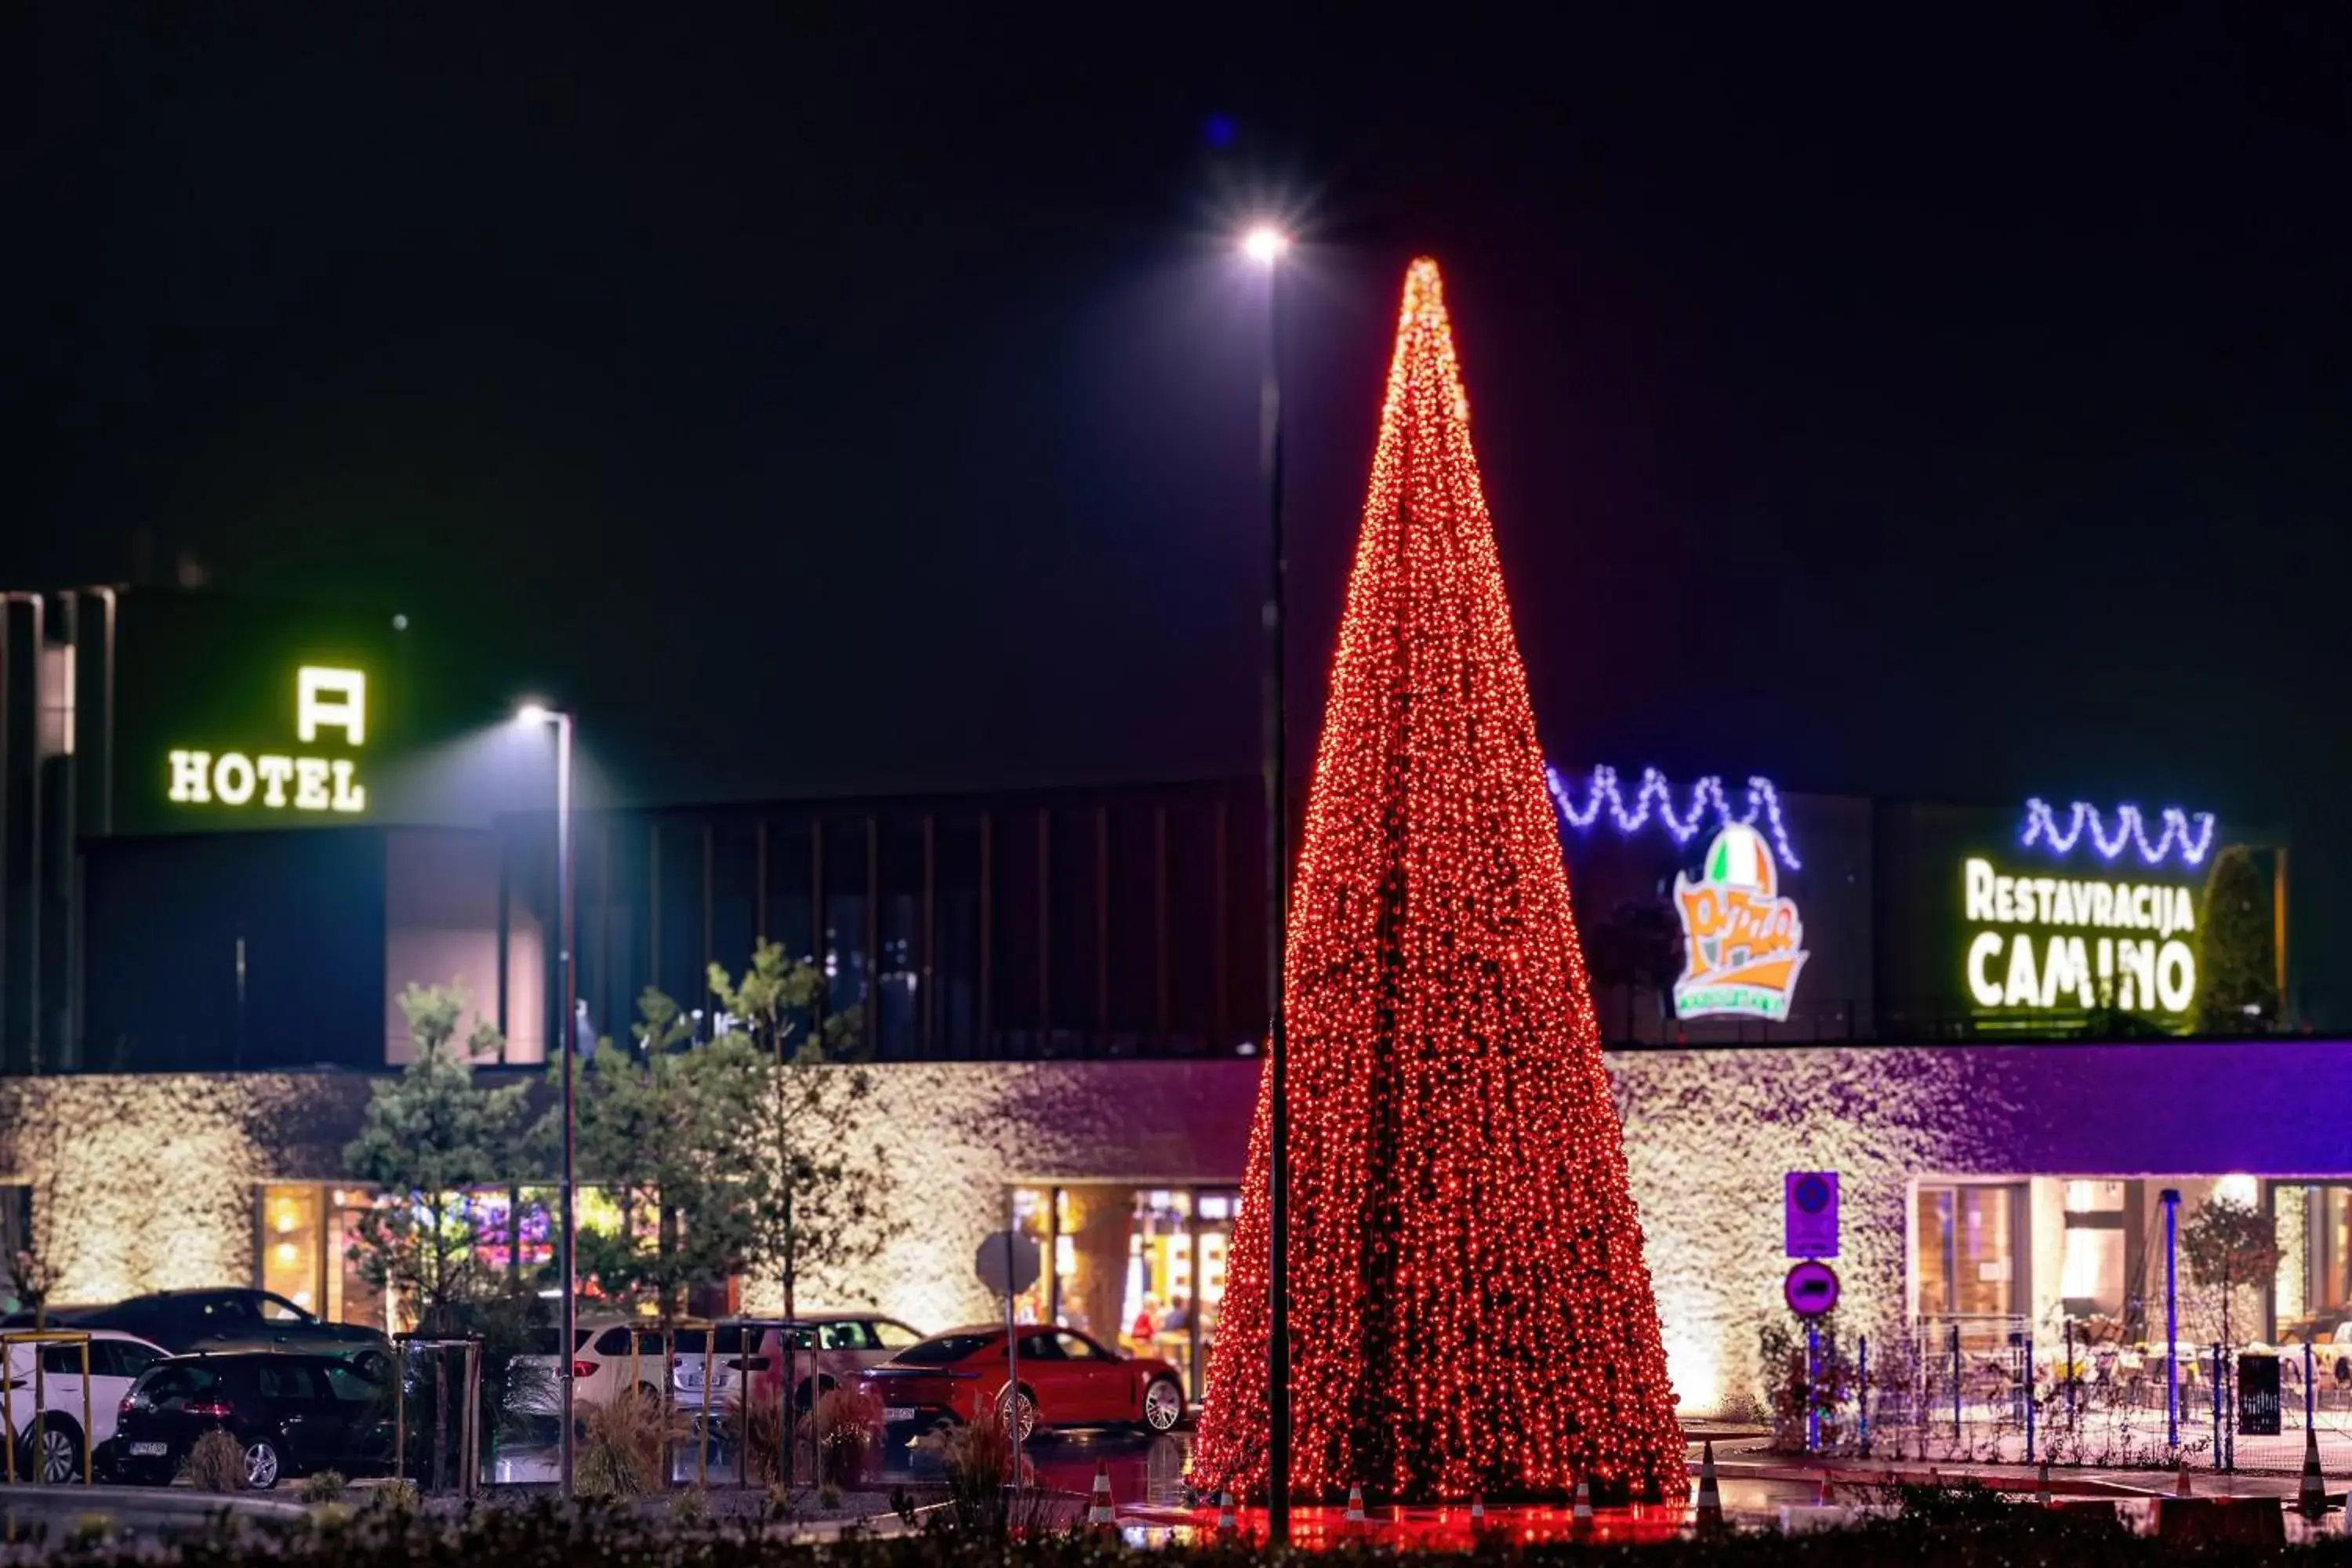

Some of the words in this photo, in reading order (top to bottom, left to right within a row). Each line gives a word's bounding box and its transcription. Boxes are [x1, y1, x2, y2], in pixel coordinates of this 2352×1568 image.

[169, 750, 365, 812] HOTEL
[1965, 858, 2195, 938] RESTAVRACIJA
[1968, 931, 2195, 1011] CAMINO
